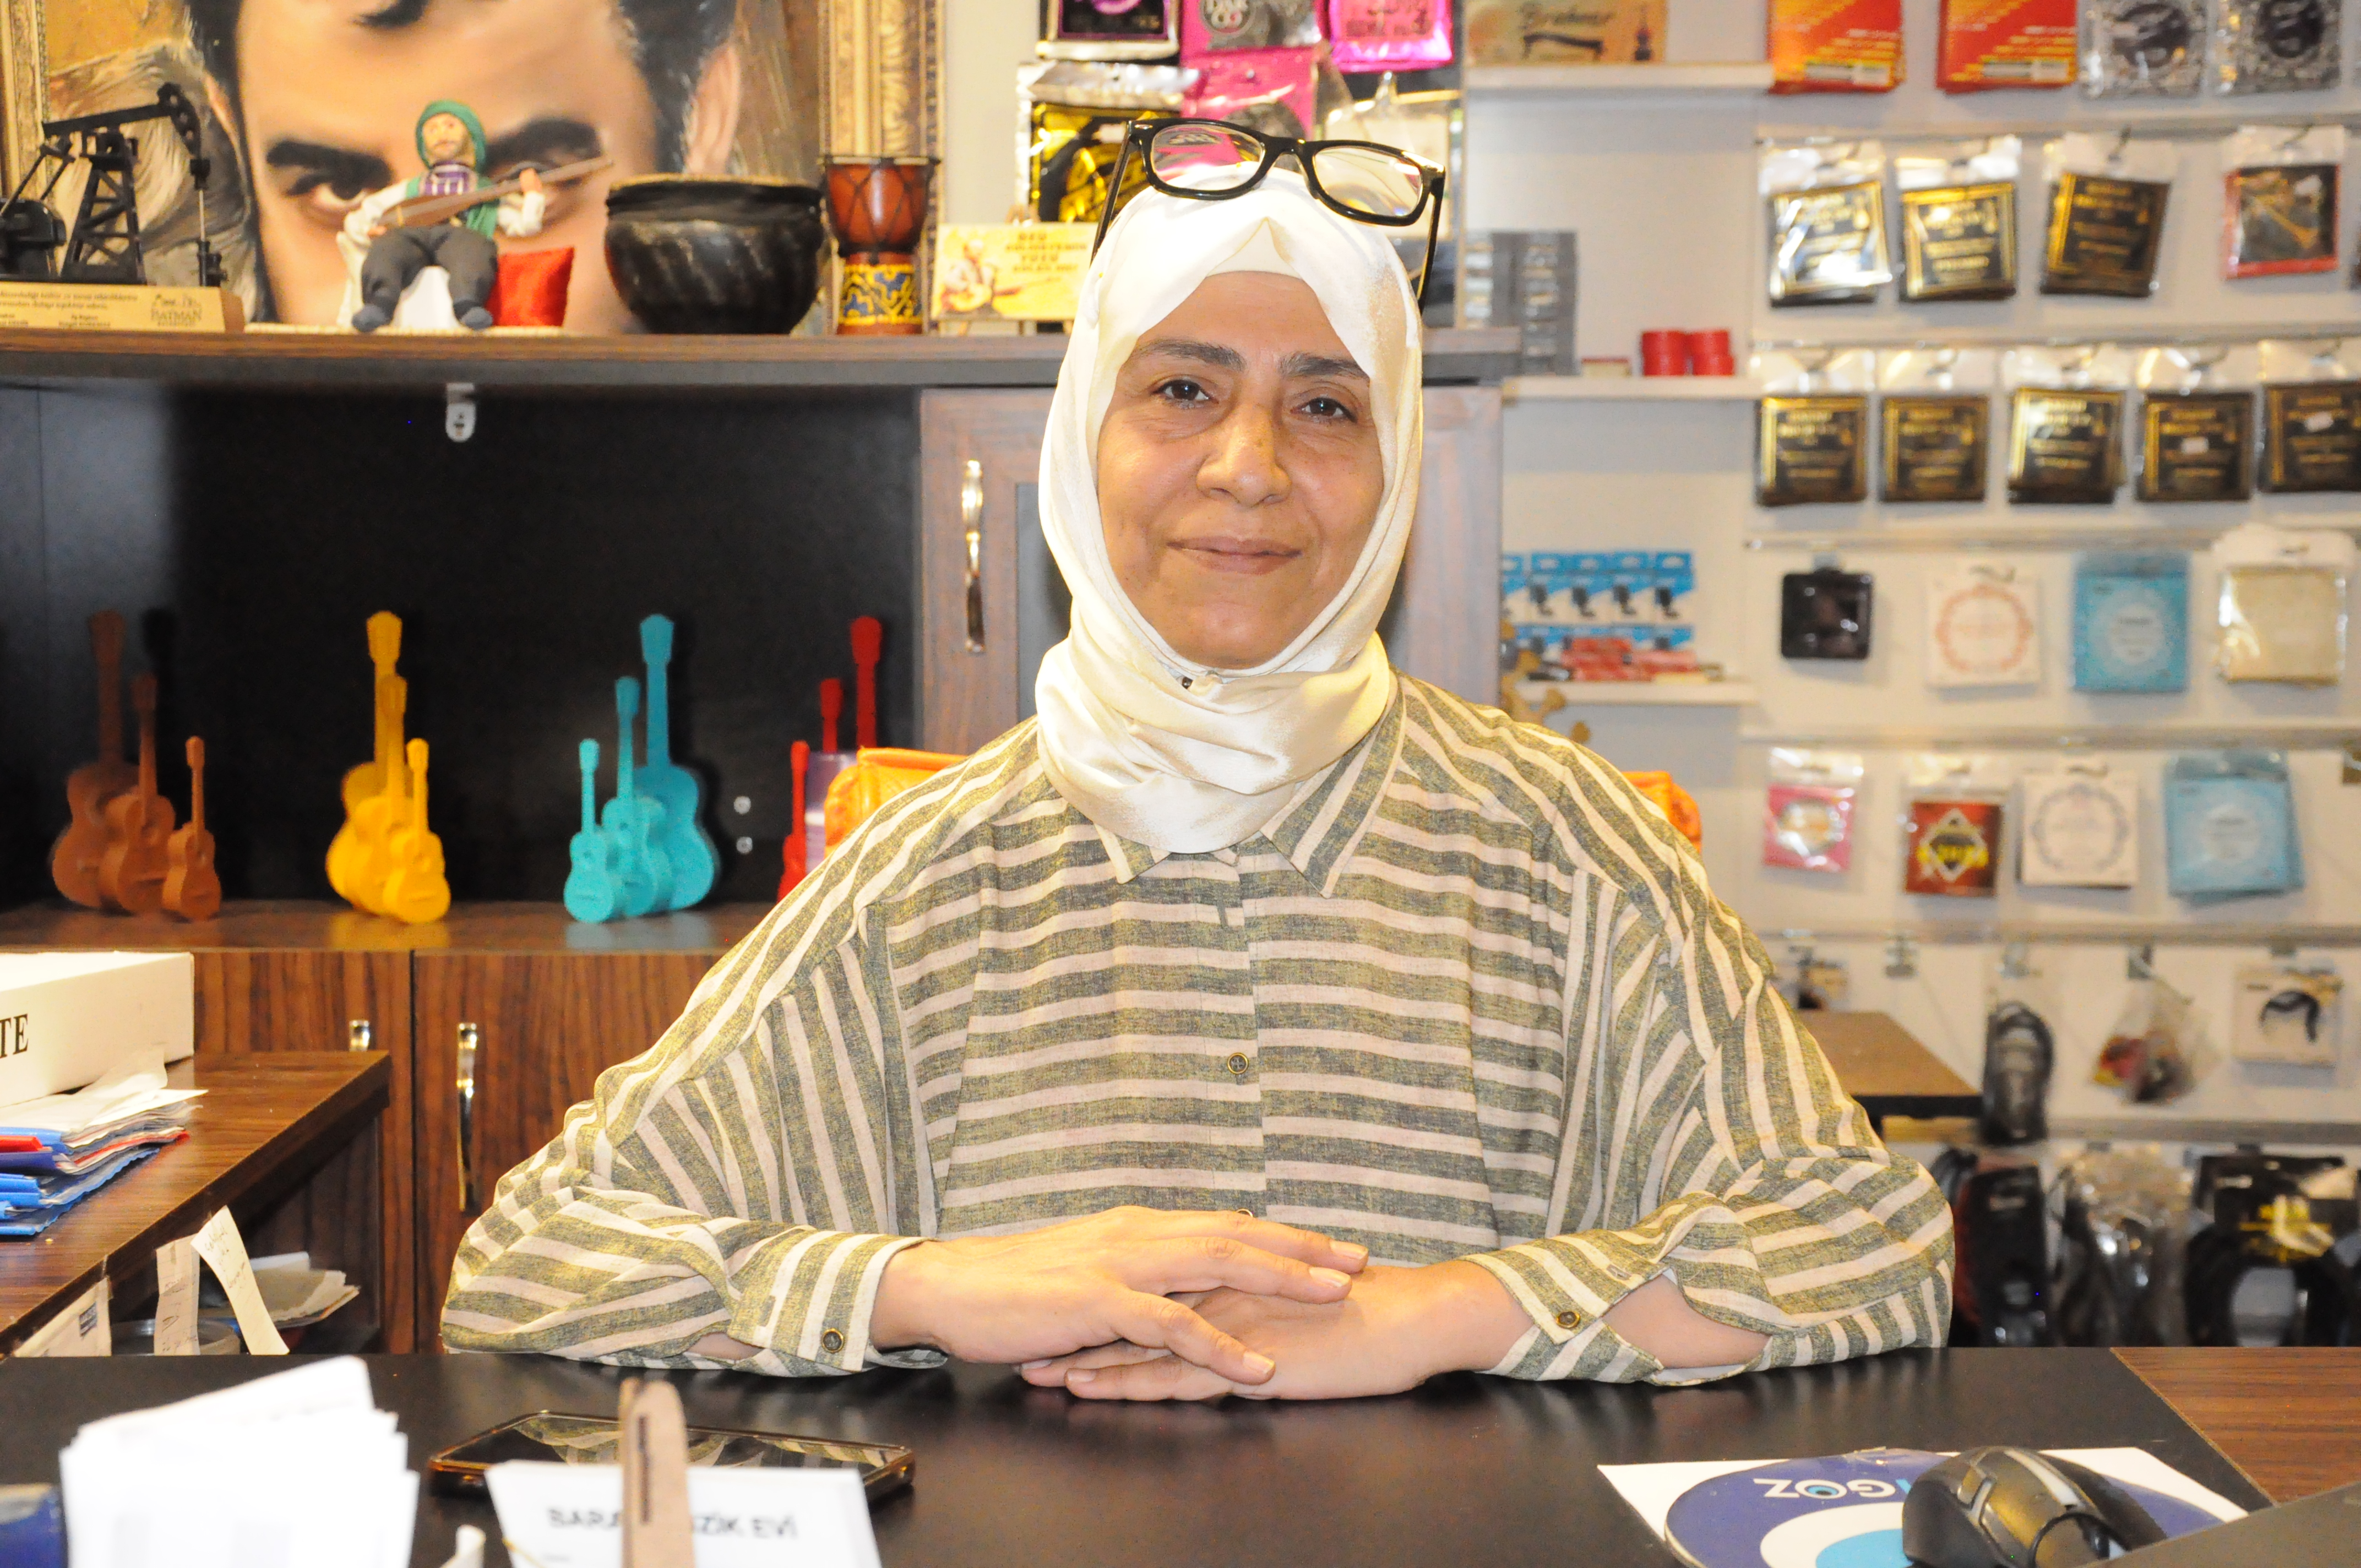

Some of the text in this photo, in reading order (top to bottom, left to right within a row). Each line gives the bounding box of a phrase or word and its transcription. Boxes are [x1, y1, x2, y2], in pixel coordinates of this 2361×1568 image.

[1753, 1478, 1912, 1500] GOZ
[547, 1507, 622, 1530] BARA
[692, 1509, 743, 1537] ZİK
